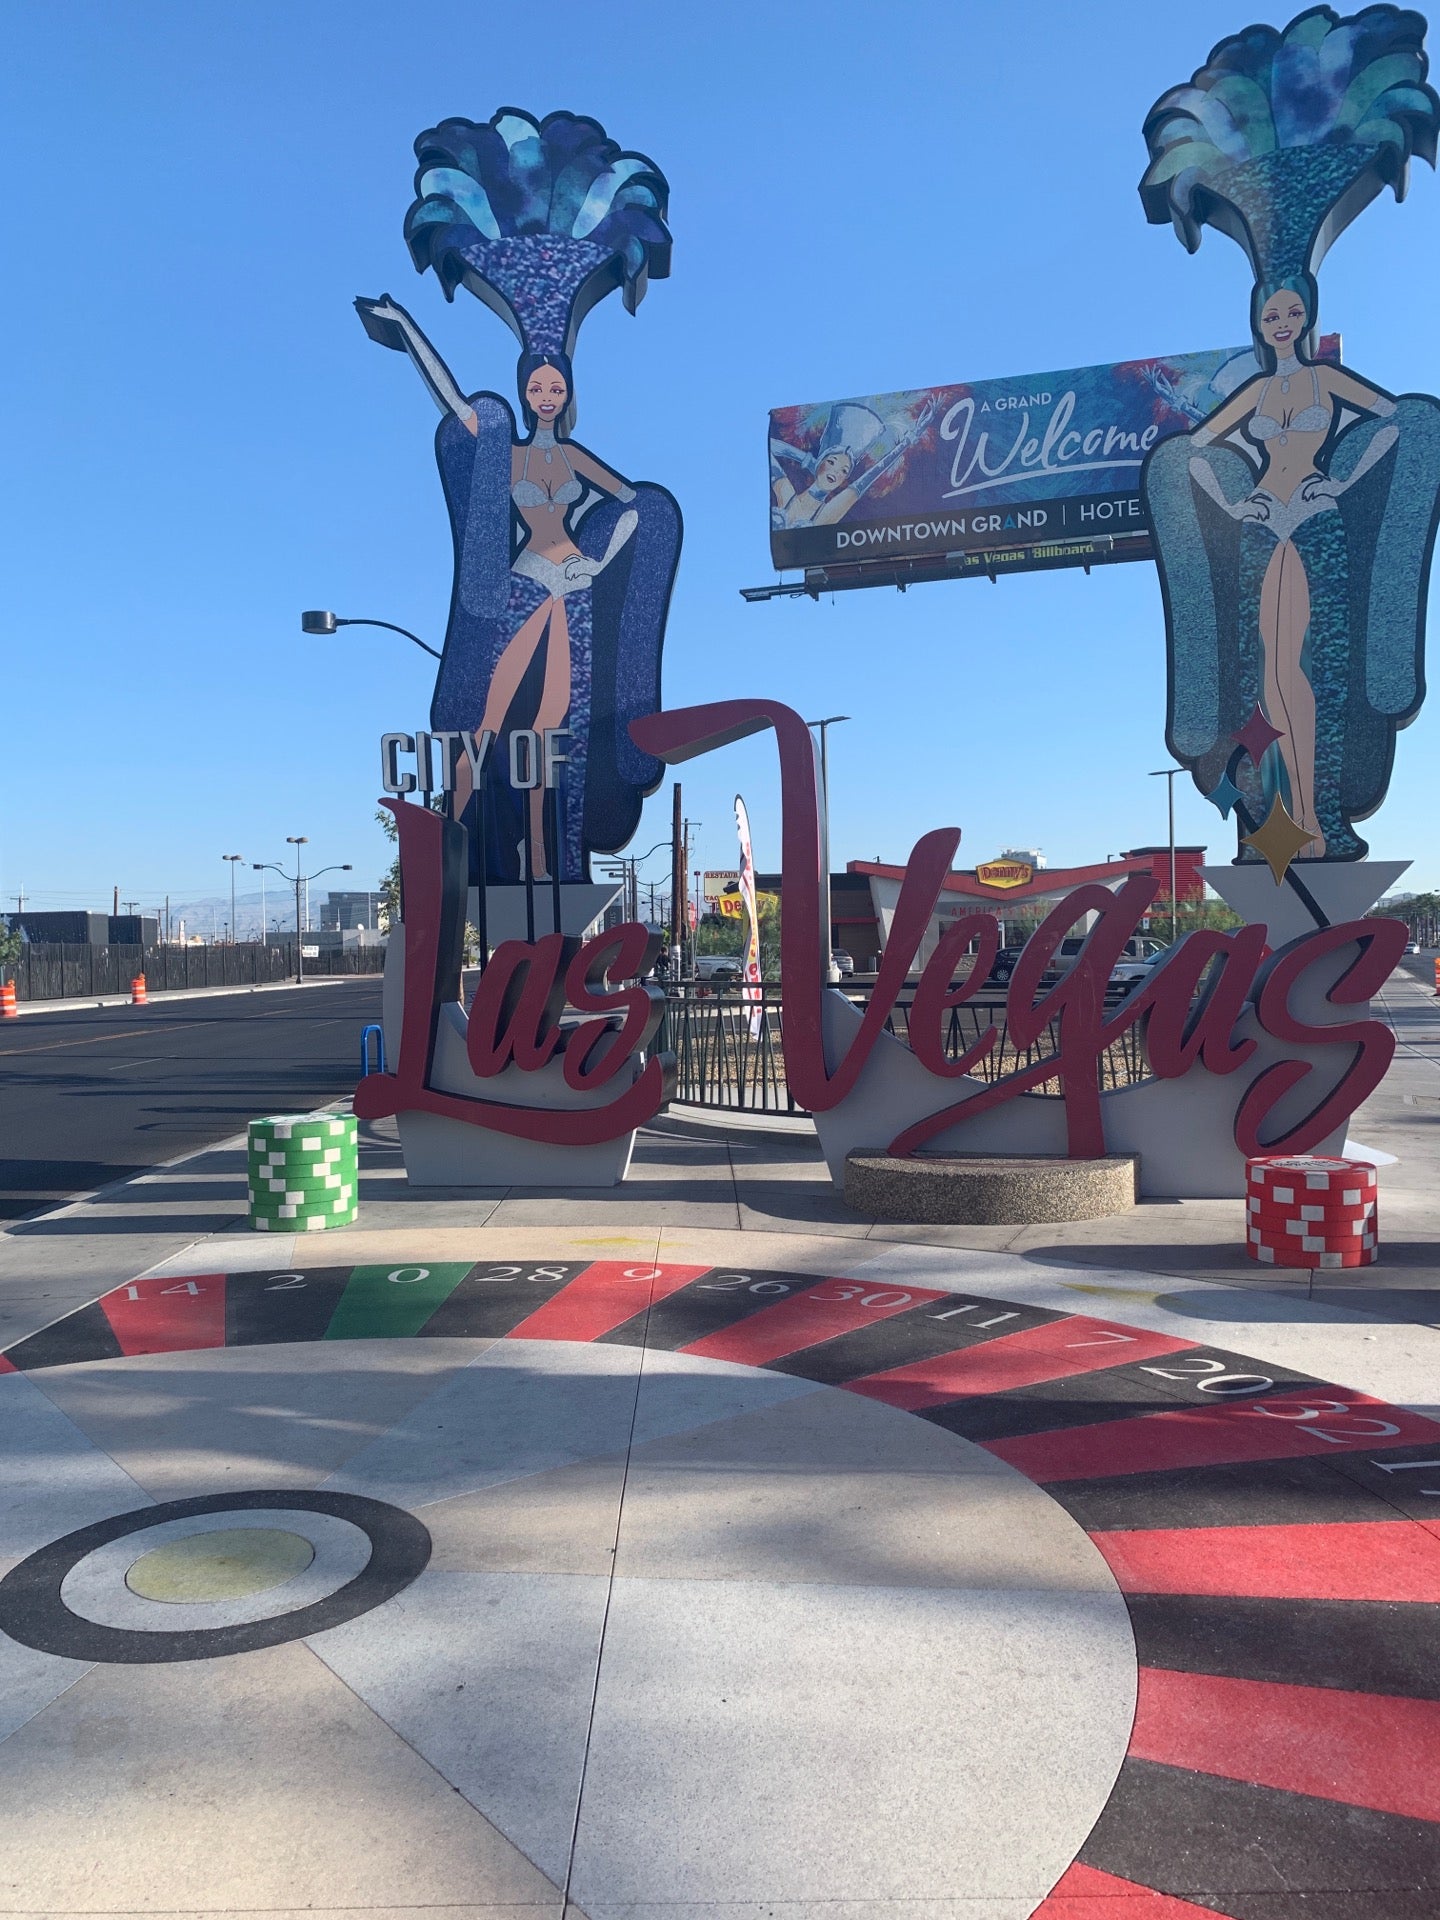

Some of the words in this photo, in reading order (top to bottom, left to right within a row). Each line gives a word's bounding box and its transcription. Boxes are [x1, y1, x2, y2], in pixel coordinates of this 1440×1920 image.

[980, 400, 991, 413] A
[995, 392, 1052, 412] GRAND
[940, 390, 1159, 488] Welcome
[836, 518, 966, 549] DOWNTOWN
[972, 510, 1048, 533] GRAND
[1080, 499, 1144, 521] HOTE
[984, 550, 1025, 564] Vegas
[1032, 543, 1094, 559] Billboard
[381, 729, 494, 793] CITY
[509, 727, 574, 790] OF
[982, 864, 1029, 880] Denny's
[628, 698, 1409, 1160] Vegas
[353, 797, 676, 1146] Las
[264, 1274, 307, 1291] 2
[387, 1267, 430, 1284] 0
[474, 1266, 569, 1283] 28
[614, 1267, 662, 1284] 9
[696, 1275, 802, 1295] 26
[122, 1281, 208, 1301] 14
[809, 1286, 912, 1308] 30
[926, 1304, 1021, 1330] 11
[1065, 1331, 1138, 1348] 7
[1139, 1358, 1274, 1394] 20
[1253, 1399, 1400, 1444] 32
